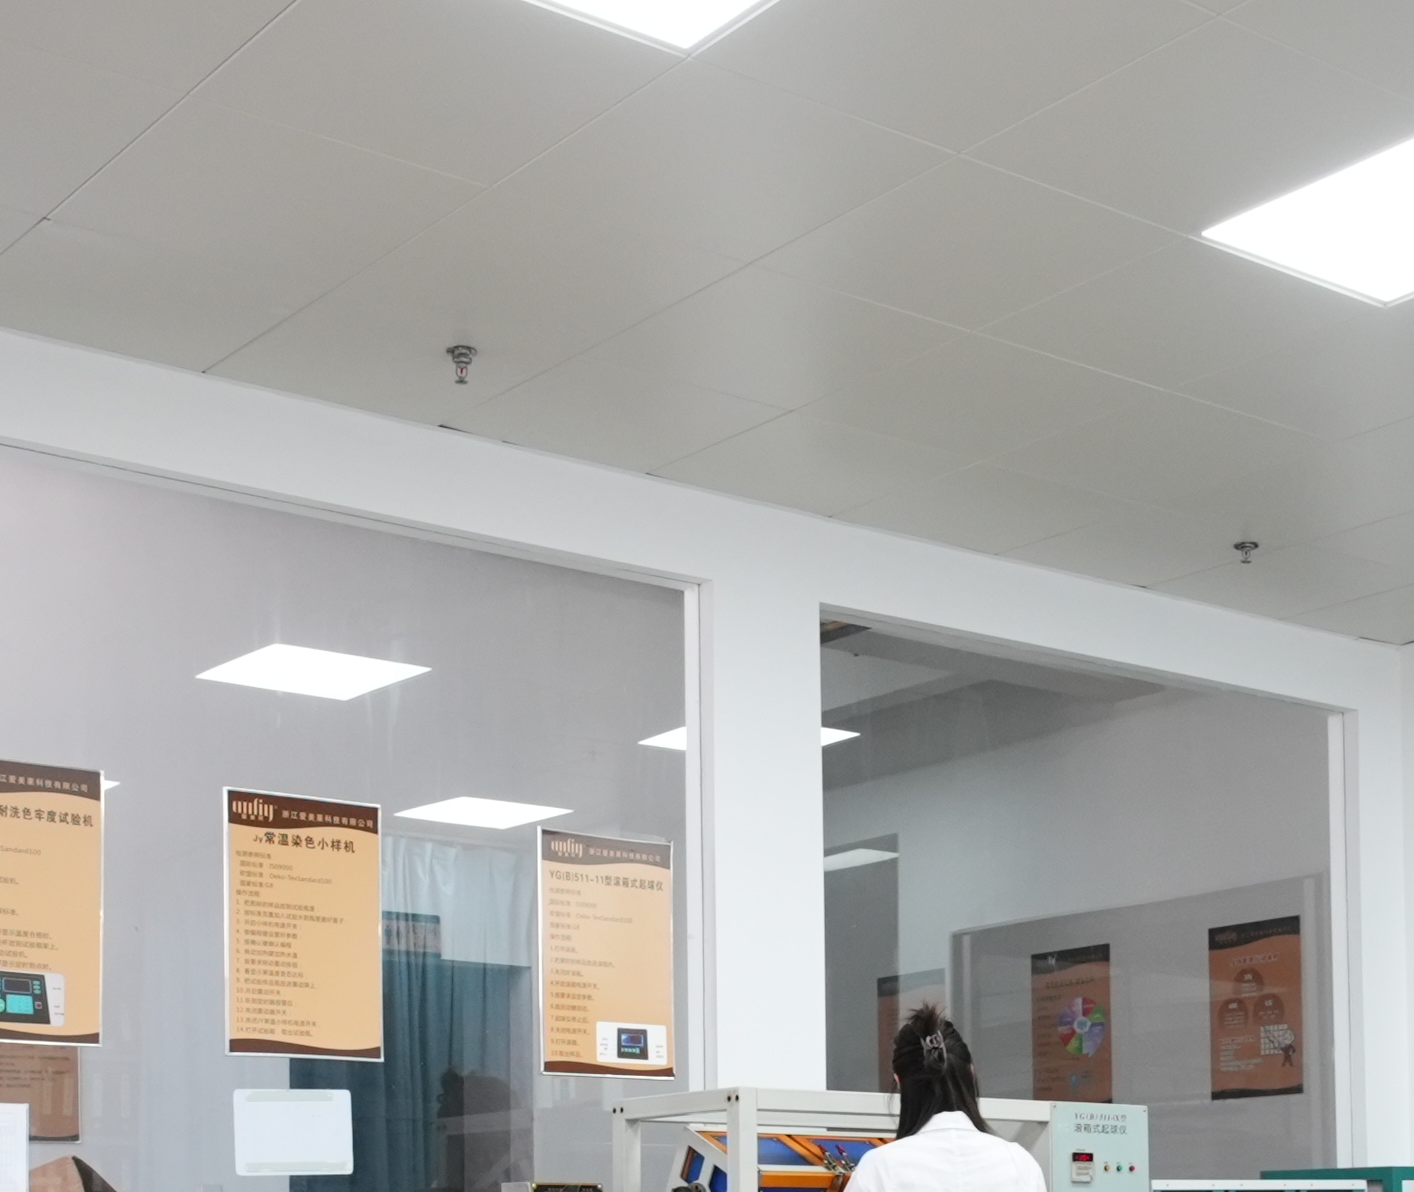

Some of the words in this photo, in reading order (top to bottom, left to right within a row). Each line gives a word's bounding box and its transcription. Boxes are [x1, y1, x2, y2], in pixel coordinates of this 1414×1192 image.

[1074, 1123, 1127, 1135] 滚箱式起球仪
